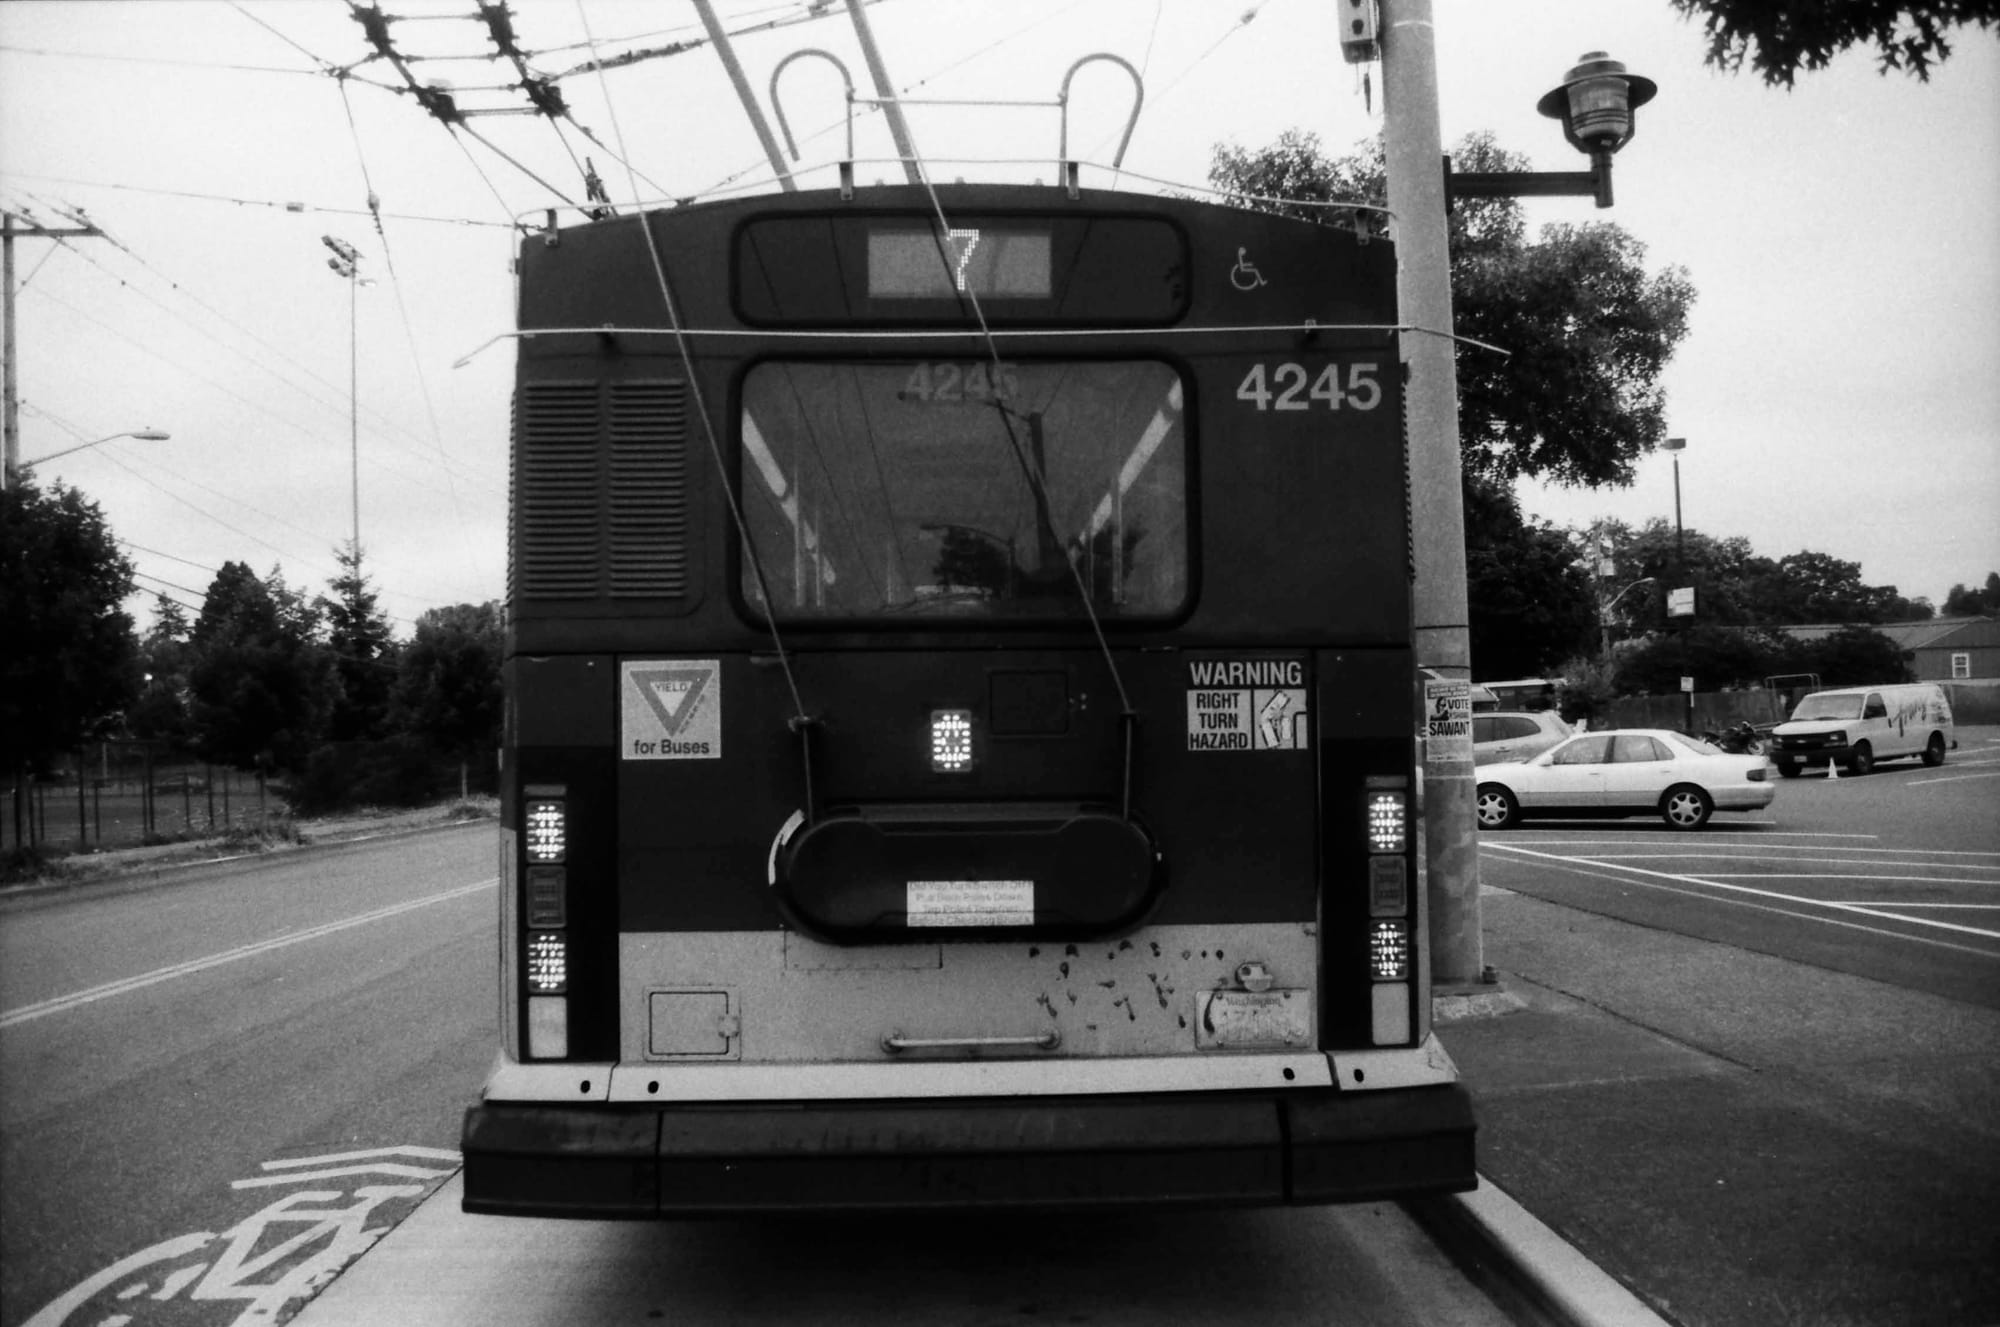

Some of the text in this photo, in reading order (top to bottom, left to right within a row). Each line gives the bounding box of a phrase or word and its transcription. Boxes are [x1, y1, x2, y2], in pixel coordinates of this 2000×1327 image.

[947, 229, 979, 291] 7
[1236, 363, 1382, 411] 4245
[1190, 661, 1302, 685] WARNING
[1196, 693, 1240, 709] RIGHT
[1447, 699, 1469, 710] VOTE
[1198, 713, 1238, 729] TURN
[1428, 721, 1470, 737] SAWANT
[634, 739, 710, 754] for Buses
[1190, 733, 1248, 749] HAZARD
